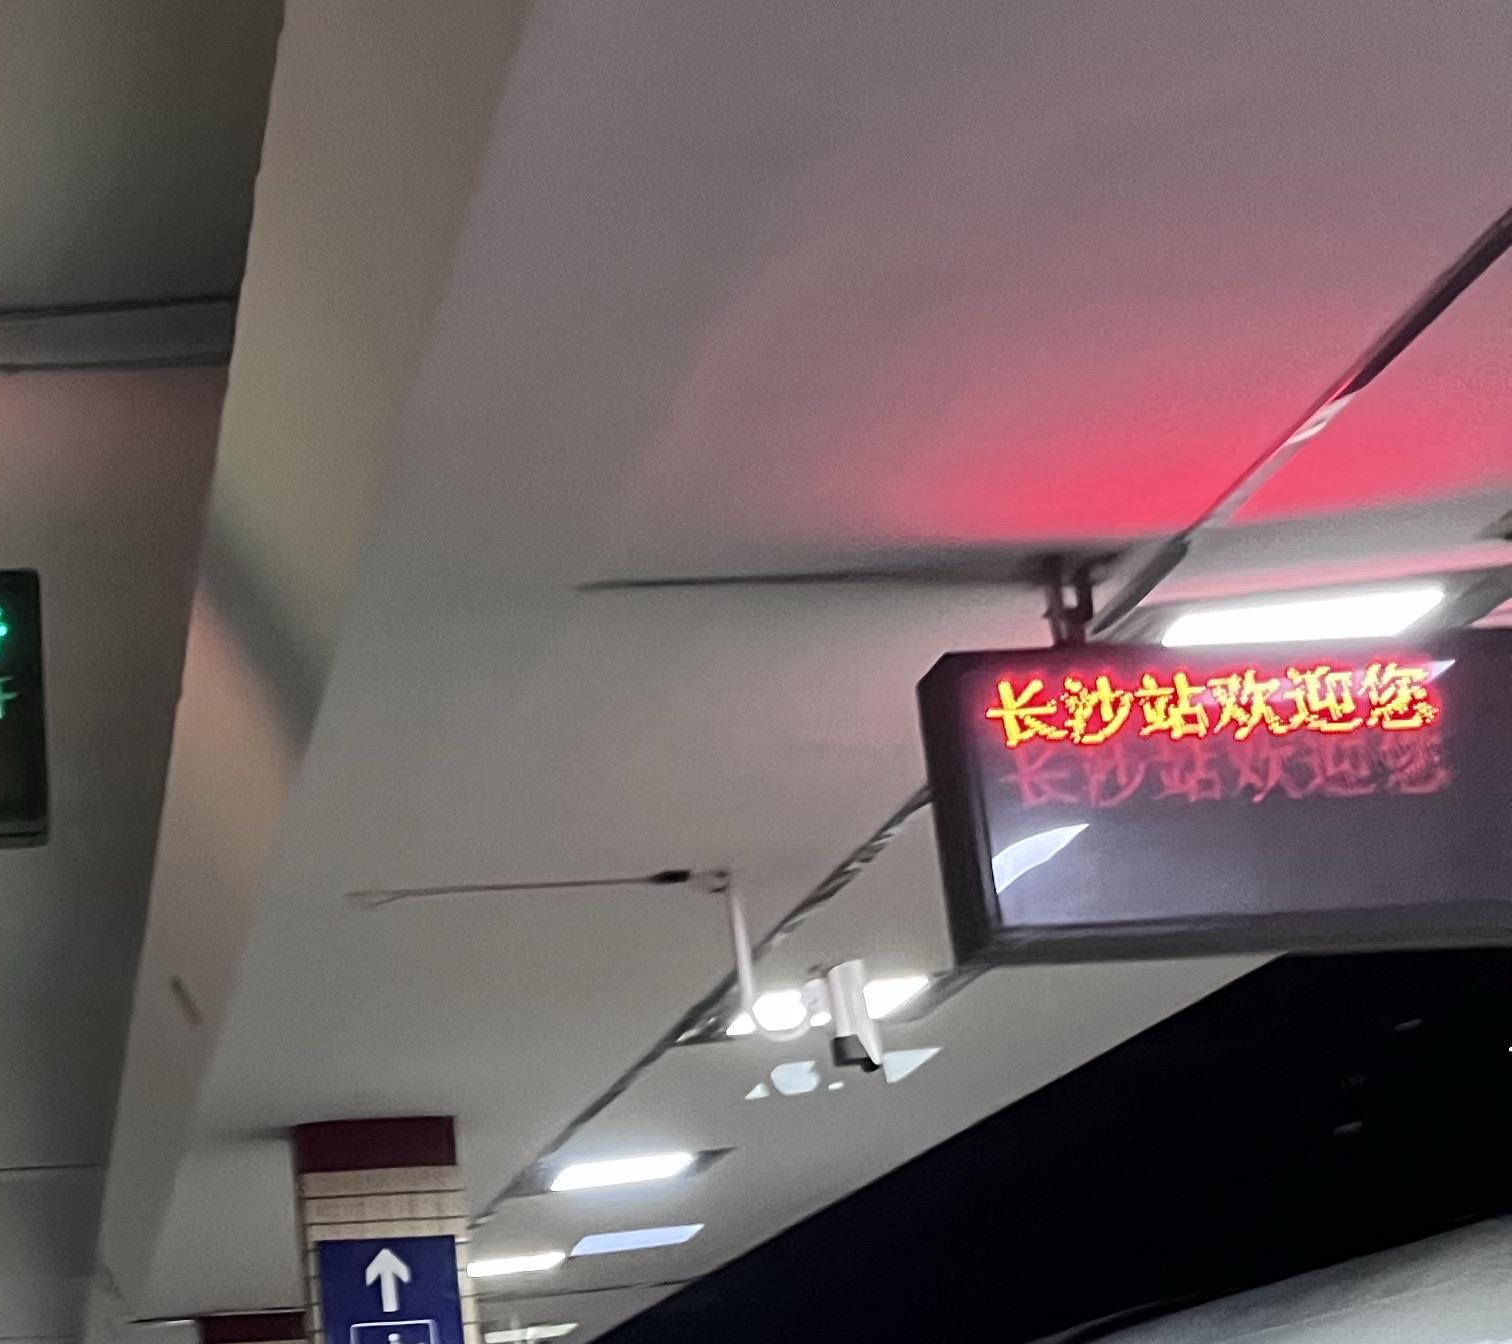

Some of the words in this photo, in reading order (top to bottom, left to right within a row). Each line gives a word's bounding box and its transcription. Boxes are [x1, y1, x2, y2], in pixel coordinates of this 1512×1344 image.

[985, 661, 1442, 746] 长沙站欢迎您
